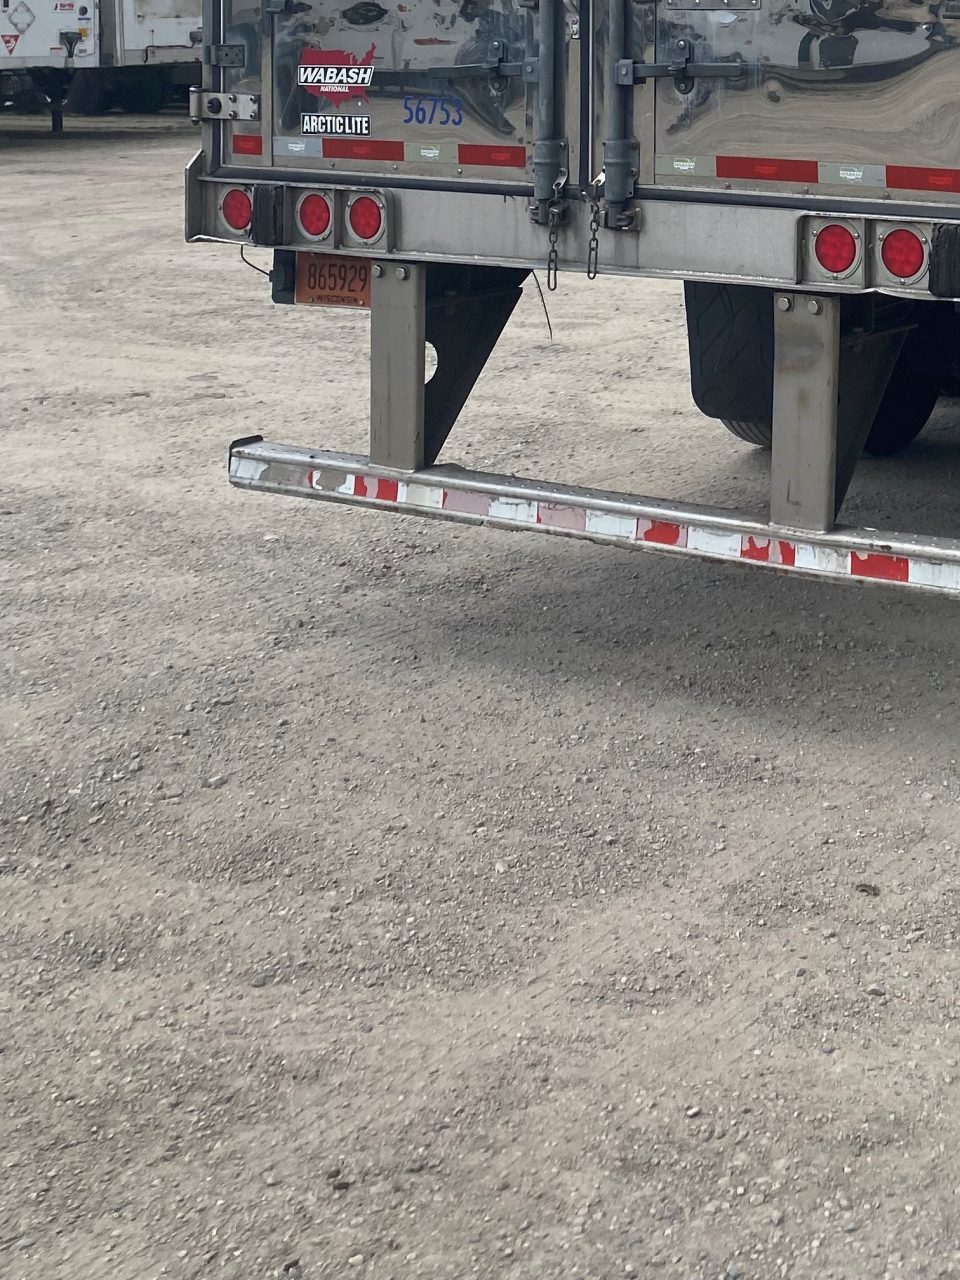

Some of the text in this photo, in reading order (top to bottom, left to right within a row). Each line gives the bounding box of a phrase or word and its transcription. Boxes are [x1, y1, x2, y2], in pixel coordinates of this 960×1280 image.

[299, 67, 372, 84] WABASH
[403, 95, 465, 126] 56753
[307, 263, 368, 292] 865929
